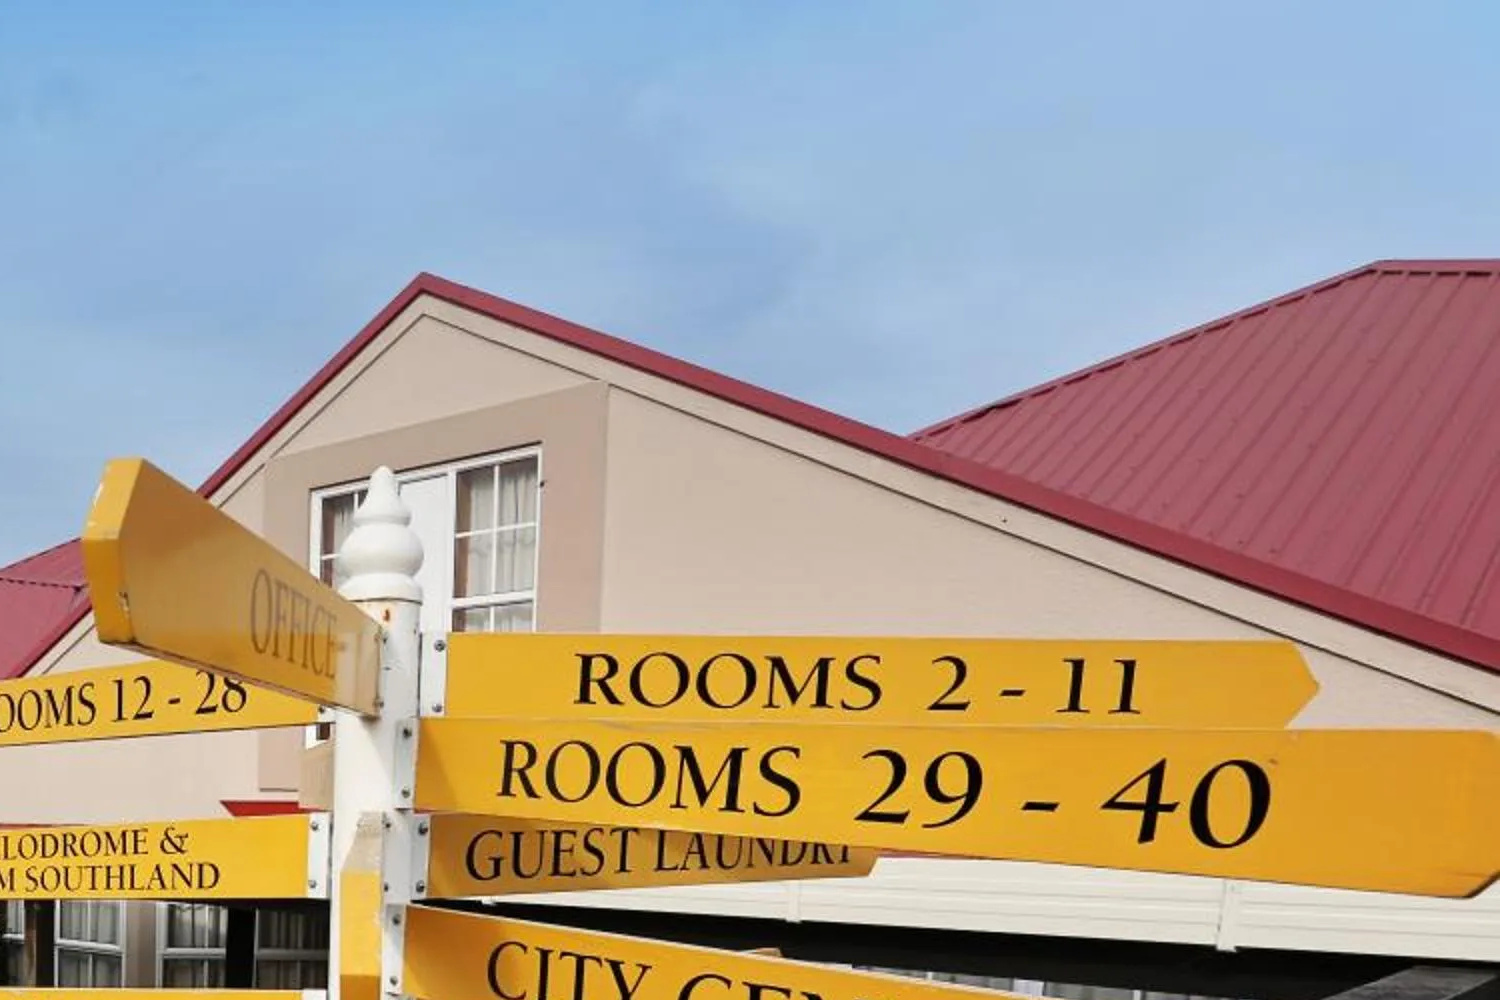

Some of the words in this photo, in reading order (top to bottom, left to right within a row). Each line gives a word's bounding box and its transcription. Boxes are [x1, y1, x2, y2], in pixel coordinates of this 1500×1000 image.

[251, 568, 338, 679] OFFICE
[111, 675, 155, 723] 12
[195, 669, 247, 714] 28
[574, 651, 882, 711] ROOMS
[927, 655, 971, 712] 2
[1056, 658, 1141, 715] 11
[497, 740, 801, 817] ROOMS
[854, 749, 983, 829] 29
[1101, 758, 1271, 849] 40
[159, 827, 190, 855] &
[465, 827, 640, 881] GUEST
[25, 861, 221, 892] SOUTHLAND
